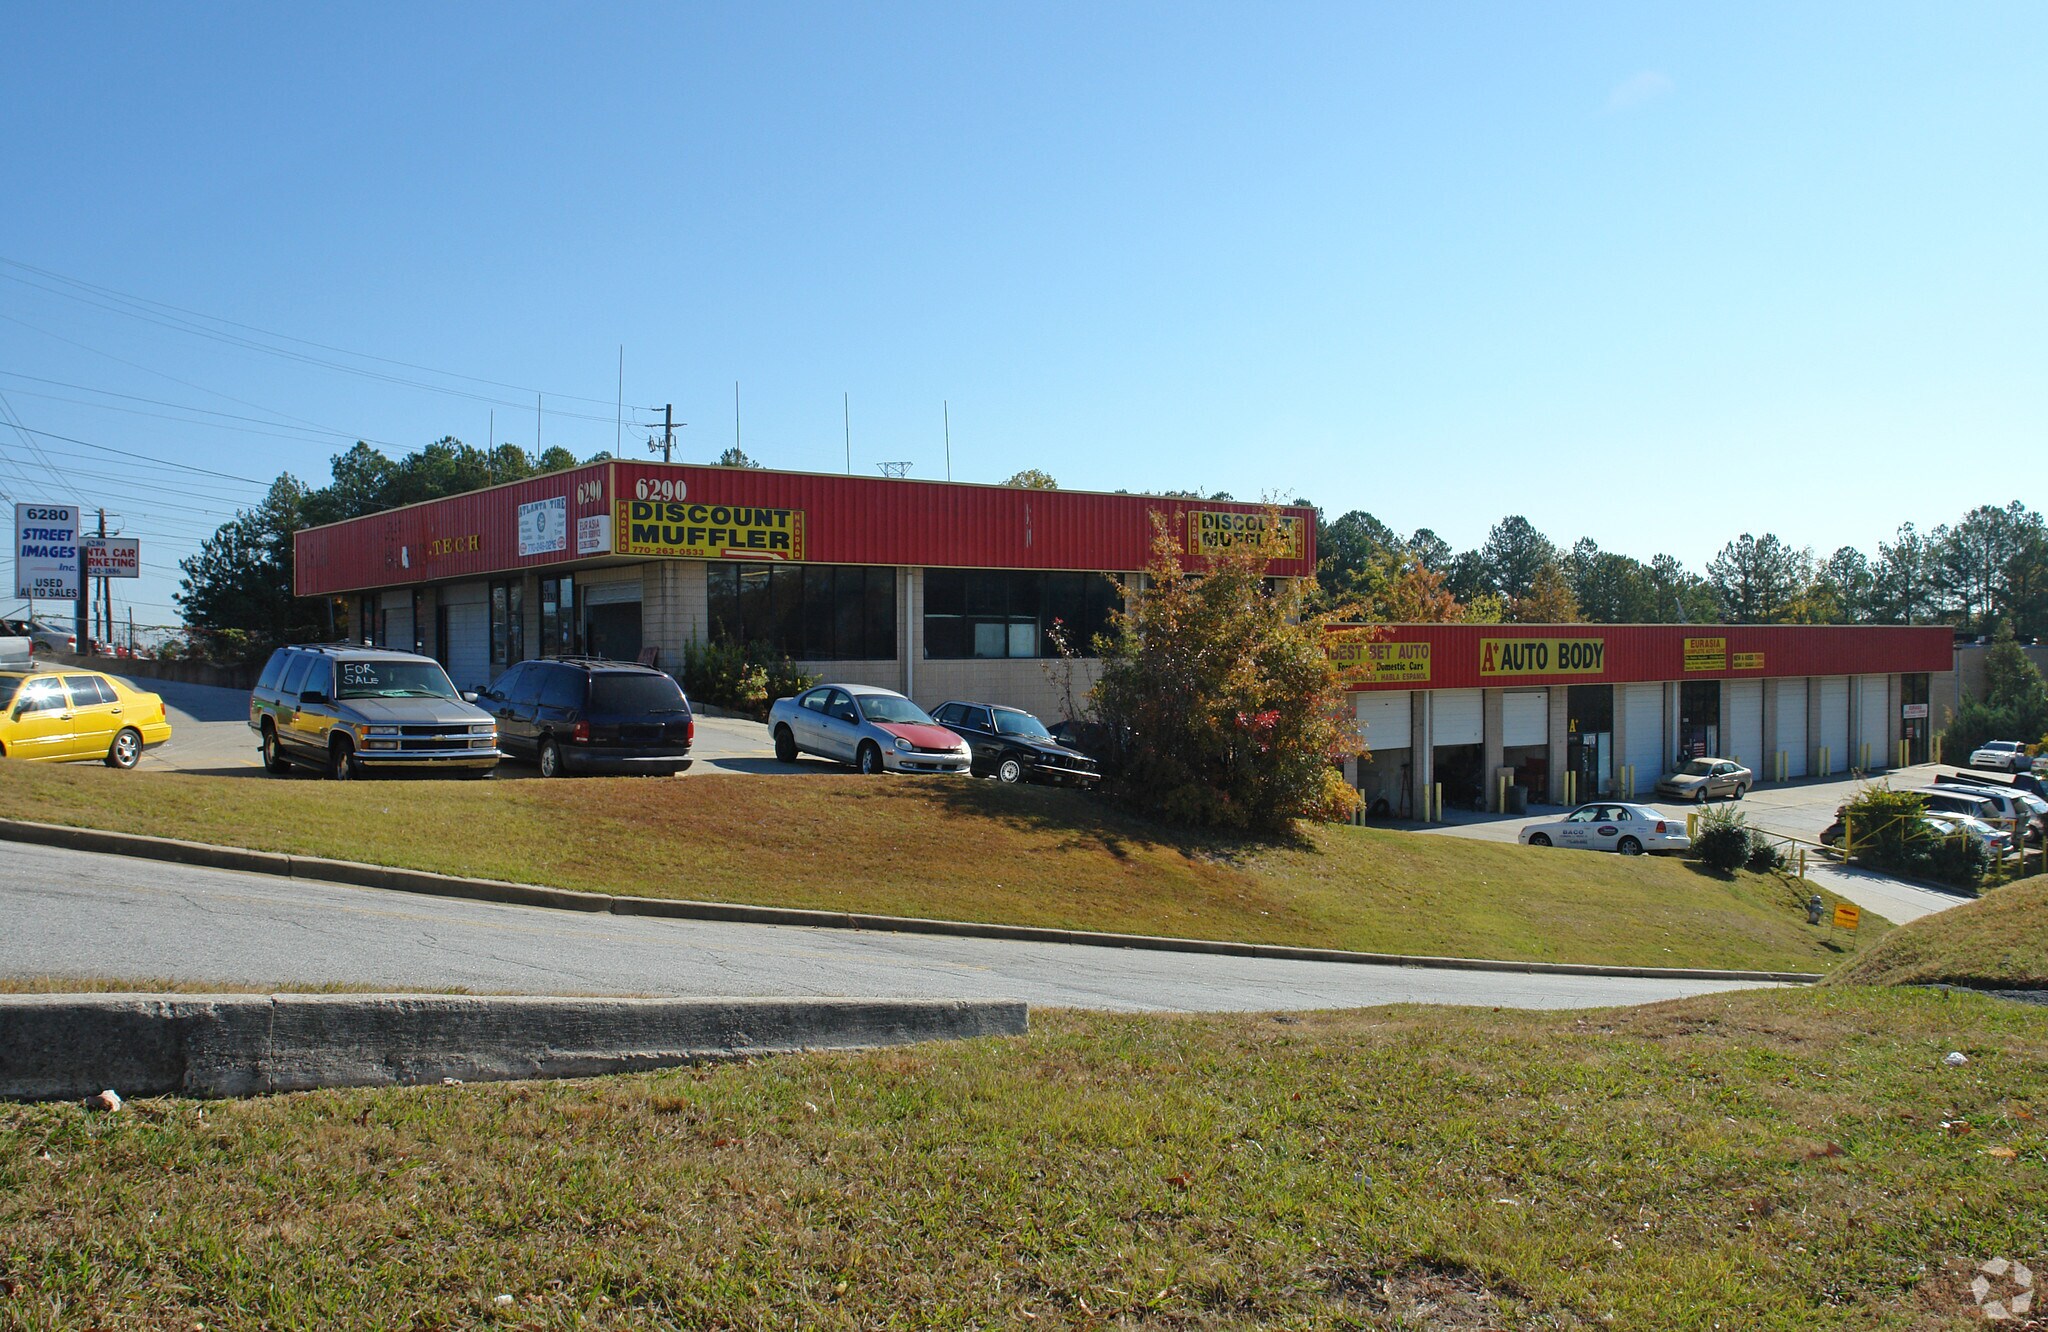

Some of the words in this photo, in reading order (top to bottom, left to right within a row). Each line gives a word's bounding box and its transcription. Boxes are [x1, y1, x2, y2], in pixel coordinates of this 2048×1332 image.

[577, 480, 602, 505] 6290
[636, 478, 687, 501] 6290
[519, 501, 546, 516] ATLANTA
[550, 497, 565, 509] TIRE
[27, 508, 69, 521] 6280
[632, 502, 791, 527] DISCOUNT
[580, 519, 599, 530] EURASIA
[619, 504, 627, 551] HADDAD
[1202, 513, 1292, 532] DISCOUT
[23, 528, 73, 541] STREET
[632, 524, 790, 549] MUFFLER
[22, 545, 75, 558] IMAGES
[112, 549, 135, 557] CAR
[632, 546, 705, 556] 770-263-0533
[59, 563, 77, 572] Inc.
[36, 579, 63, 588] USED
[49, 588, 77, 598] SALES
[1691, 640, 1720, 648] EURASIA
[1331, 644, 1362, 660] BEST
[1369, 644, 1392, 660] BET
[1398, 644, 1429, 659] AUTO
[1500, 642, 1548, 670] AUTO
[1558, 642, 1604, 669] BODY
[344, 663, 375, 674] FOR
[1376, 662, 1405, 671] Domestic
[1409, 661, 1424, 670] Cars
[343, 675, 379, 685] SALE
